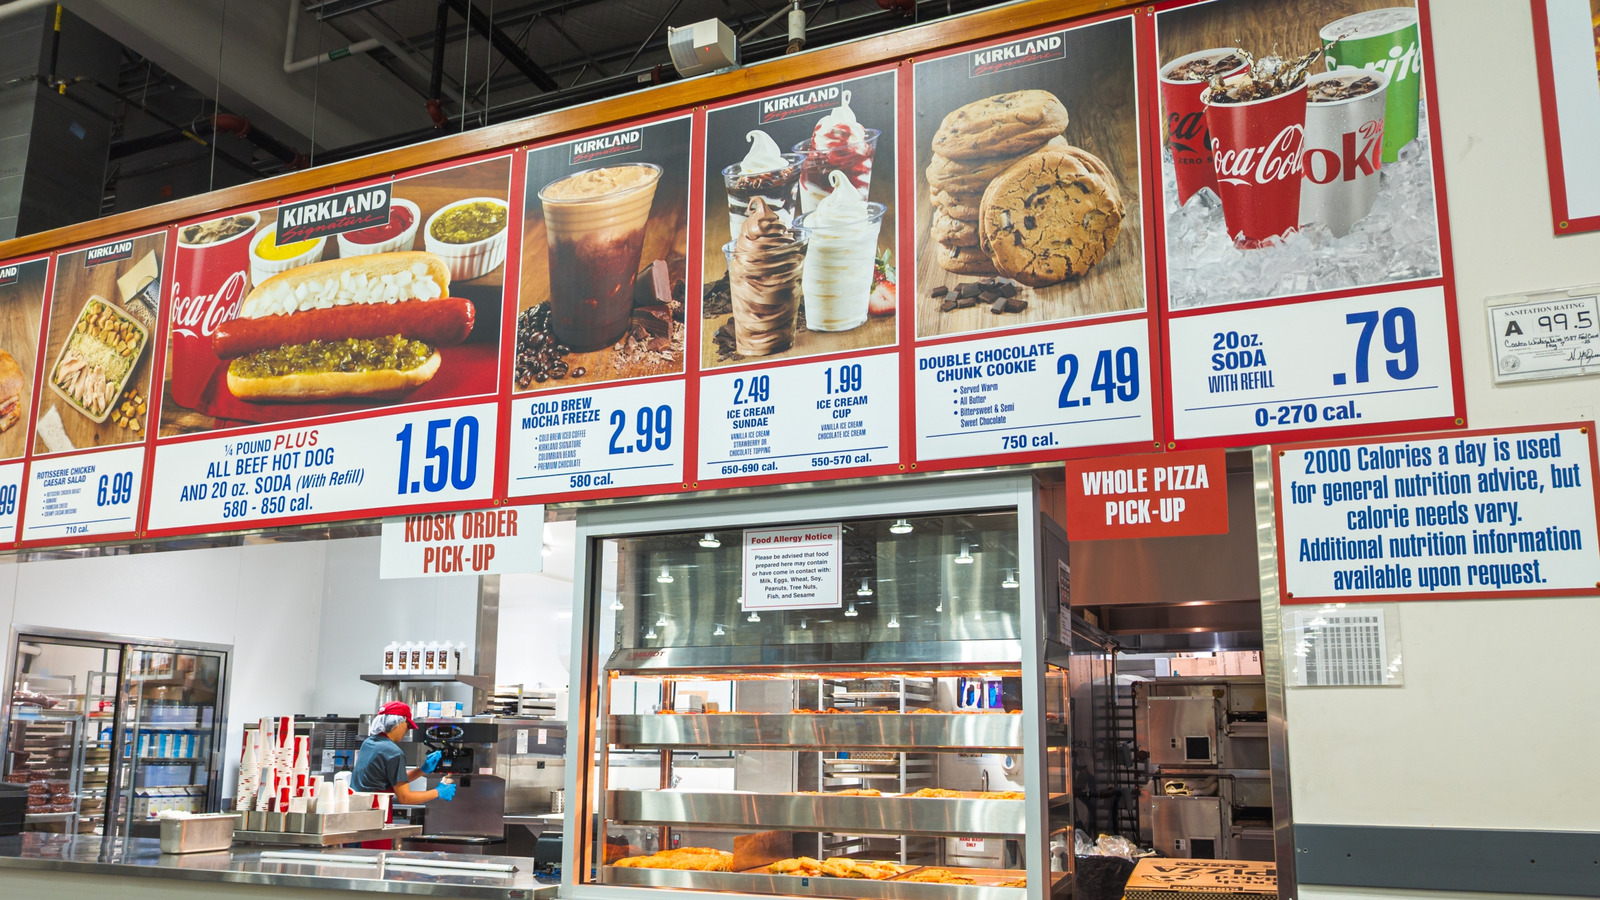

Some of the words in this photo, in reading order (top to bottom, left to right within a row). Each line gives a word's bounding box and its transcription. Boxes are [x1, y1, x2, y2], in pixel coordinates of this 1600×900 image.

[974, 36, 1061, 66] KIRKLAND
[974, 52, 1062, 75] Signature
[764, 86, 839, 113] KIRKLAND
[764, 102, 839, 122] Signature
[574, 131, 640, 154] KIRKLAND
[574, 145, 638, 163] Signature
[282, 190, 387, 228] KIRKLAND
[281, 213, 385, 244] Signature
[88, 242, 132, 259] KIRKLAND
[1505, 306, 1552, 316] SANITATION
[1554, 302, 1585, 311] RATING
[1505, 320, 1523, 336] A
[919, 353, 970, 370] DOUBLE
[975, 342, 1054, 364] CHOCOLATE
[1333, 306, 1419, 385] .79
[936, 365, 982, 383] CHUNK
[987, 359, 1036, 377] COOKIE
[1212, 349, 1267, 371] SODA
[824, 364, 862, 394] 1.99
[960, 384, 979, 394] Served
[981, 383, 998, 392] Warm
[1056, 346, 1139, 408] 2.49
[1208, 374, 1238, 393] WITH
[1241, 370, 1274, 390] REFILL
[733, 375, 770, 405] 2.49
[960, 396, 968, 405] All
[970, 395, 986, 404] Butter
[531, 401, 558, 415] COLD
[561, 397, 592, 411] BREW
[727, 410, 740, 419] ICE
[743, 406, 775, 417] CREAM
[817, 400, 831, 410] ICE
[834, 395, 868, 408] CREAM
[832, 408, 851, 419] CUP
[960, 405, 992, 417] Bittersweet
[994, 405, 999, 413] &
[1000, 403, 1014, 413] Semi
[1255, 404, 1317, 427] 0-270
[1323, 400, 1362, 421] cal.
[522, 414, 559, 430] MOCHA
[562, 409, 600, 425] FREEZE
[608, 405, 672, 454] 2.99
[733, 417, 768, 429] SUNDAE
[821, 423, 839, 431] VANILLA
[847, 420, 863, 429] CREAM
[961, 418, 978, 428] Sweet
[980, 415, 1006, 426] Chocolate
[236, 439, 271, 455] POUND
[274, 430, 319, 450] PLUS
[538, 442, 558, 451] KIRKLAND
[559, 440, 581, 449] SIGNATURE
[539, 433, 549, 442] COLD
[549, 432, 561, 441] BREW
[562, 431, 571, 440] ICED
[572, 429, 586, 439] COFFEE
[818, 432, 842, 440] CHOCOLATE
[850, 429, 866, 438] CREAM
[1002, 435, 1027, 449] 750
[1032, 432, 1058, 447] cal.
[206, 462, 231, 478] ALL
[236, 456, 268, 476] BEEF
[272, 452, 301, 471] HOT
[305, 447, 334, 468] DOG
[395, 416, 479, 495] 1.50
[538, 461, 557, 470] PREMIUM
[558, 458, 581, 468] CHOCOLATE
[812, 456, 852, 467] 550-570
[854, 453, 872, 463] cal.
[1304, 448, 1351, 475] 2000
[1358, 444, 1432, 471] Calories
[1438, 446, 1449, 465] a
[1456, 440, 1486, 467] day
[1493, 437, 1510, 462] is
[1518, 433, 1561, 460] used
[37, 468, 69, 480] ROTISSERIE
[70, 465, 96, 475] CHICKEN
[721, 464, 759, 475] 650-690
[762, 462, 778, 472] cal.
[1082, 468, 1148, 496] WHOLE
[1154, 464, 1209, 492] PIZZA
[44, 477, 66, 487] CAESAR
[67, 475, 86, 484] SALAD
[97, 471, 133, 506] 6.99
[180, 483, 207, 502] AND
[211, 481, 227, 499] 20
[232, 482, 249, 497] oz.
[254, 475, 291, 494] SODA
[296, 475, 327, 493] (With
[329, 468, 364, 487] Refill)
[570, 474, 591, 488] 580
[594, 473, 614, 486] cal.
[1291, 481, 1317, 504] for
[1323, 475, 1388, 506] general
[1395, 470, 1471, 498] nutrition
[1478, 467, 1544, 494] advice,
[1550, 463, 1581, 489] but
[223, 500, 248, 518] 580
[261, 495, 286, 514] 850
[289, 493, 313, 512] cal.
[1106, 497, 1185, 526] PICK-UP
[1347, 504, 1410, 530] calorie
[1416, 500, 1468, 526] needs
[1474, 500, 1523, 526] vary.
[66, 526, 77, 534] 710
[78, 525, 88, 533] cal.
[404, 513, 456, 543] KIOSK
[462, 509, 518, 540] ORDER
[751, 536, 771, 544] Food
[774, 535, 802, 543] Allergy
[1299, 535, 1384, 562] Additional
[1389, 530, 1467, 558] nutrition
[1472, 526, 1582, 555] information
[423, 544, 495, 573] PICK-UP
[1333, 563, 1412, 590] available
[1418, 565, 1461, 591] upon
[1467, 559, 1547, 589] request.
